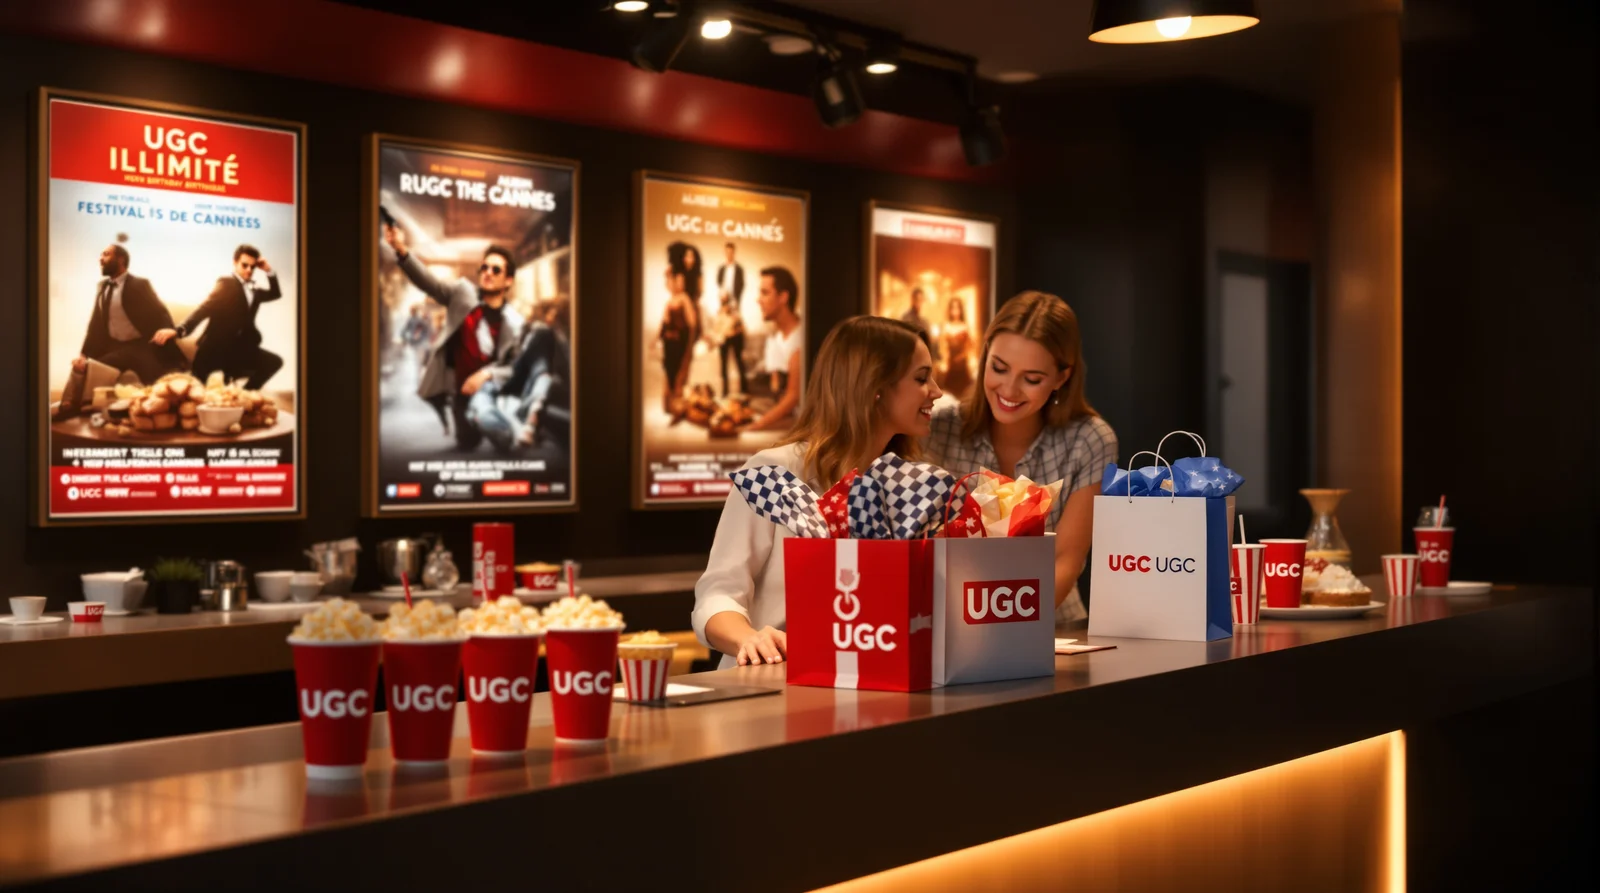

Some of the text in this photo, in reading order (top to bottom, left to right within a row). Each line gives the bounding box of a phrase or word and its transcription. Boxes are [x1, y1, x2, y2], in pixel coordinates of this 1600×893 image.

[144, 125, 208, 155] UGC
[110, 146, 239, 185] ILLIMITÉ
[400, 173, 453, 198] RUGC
[456, 179, 486, 203] THE
[489, 185, 556, 212] CANNES
[77, 201, 145, 219] FESTIVAL
[170, 210, 187, 222] DE
[193, 212, 261, 229] CANNESS
[666, 213, 702, 234] UGC
[722, 217, 784, 243] CANNÉS
[1108, 554, 1196, 573] UGC UGC
[1265, 562, 1301, 578] UGC
[967, 585, 1036, 620] UGC
[832, 622, 897, 652] UGC
[392, 684, 454, 712] UGC
[469, 676, 530, 703] UGC
[553, 670, 612, 696] UGC
[301, 688, 369, 718] UGC
